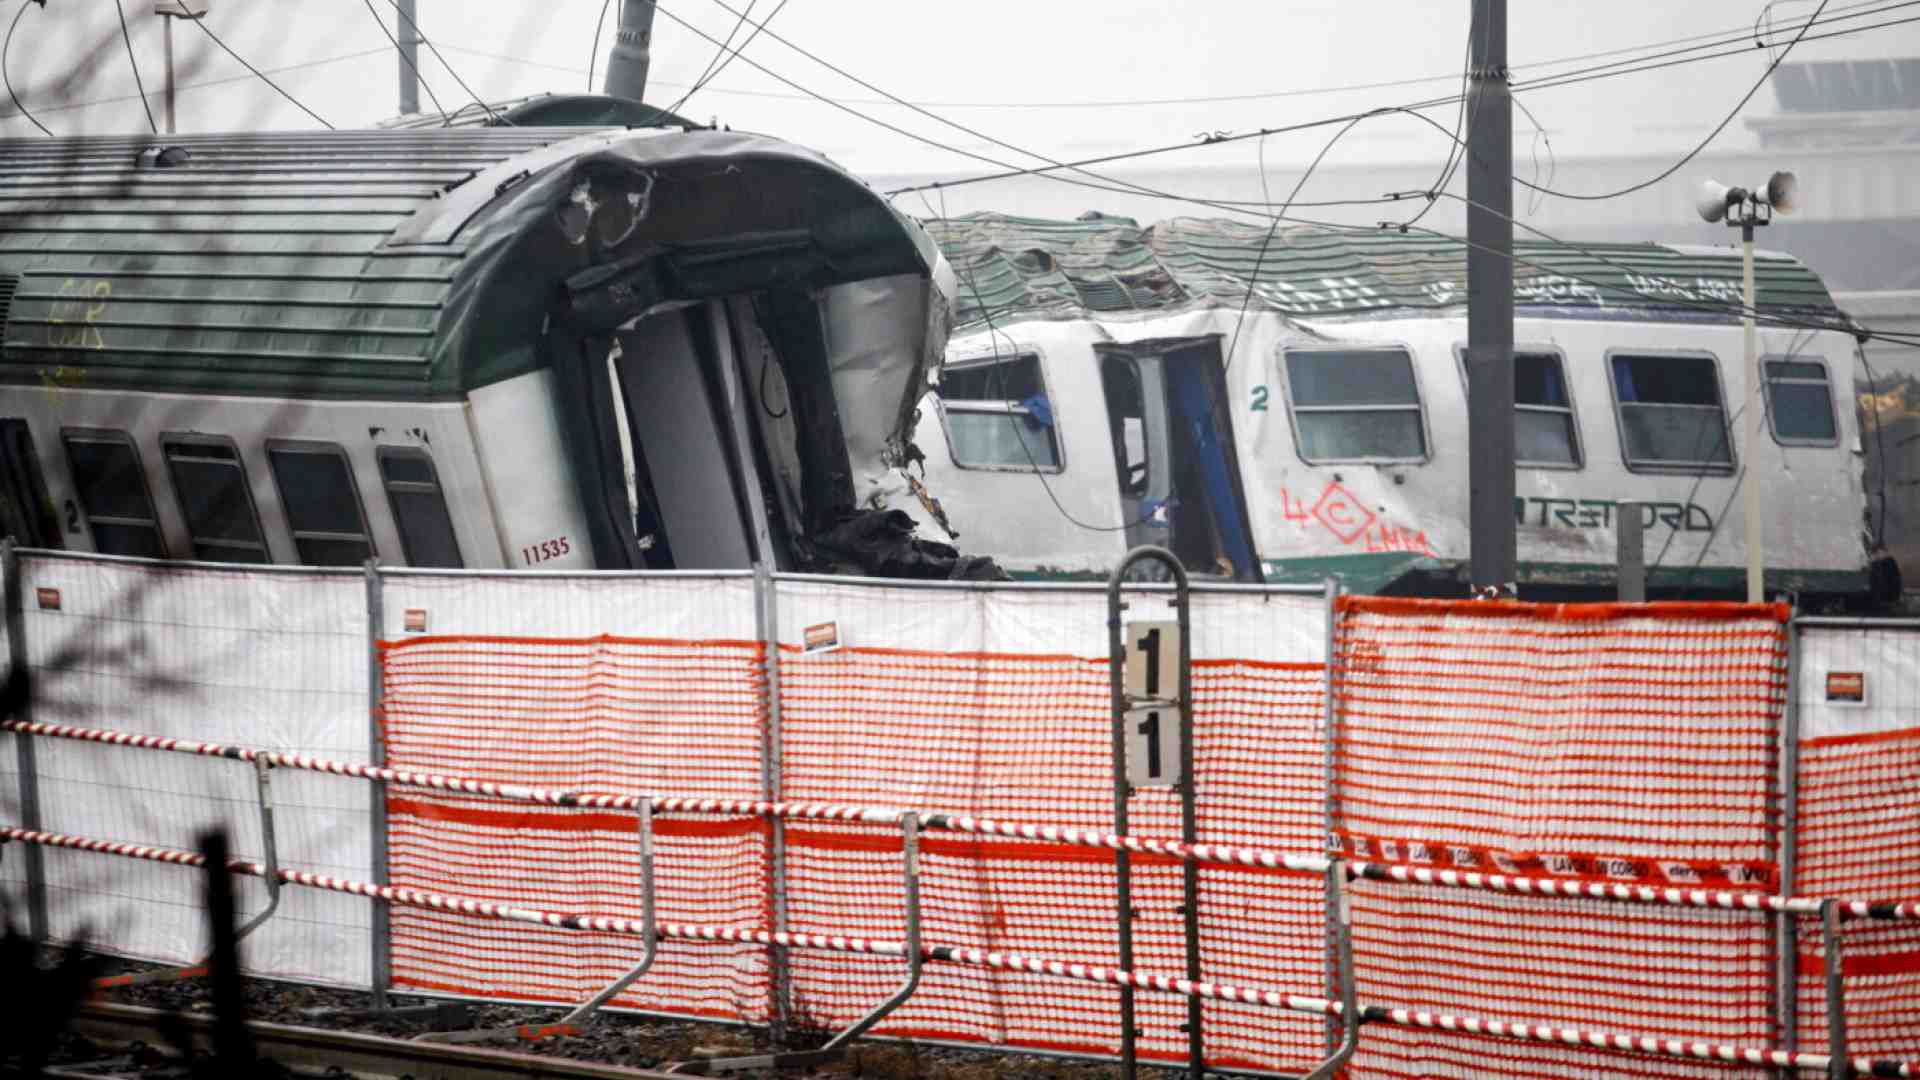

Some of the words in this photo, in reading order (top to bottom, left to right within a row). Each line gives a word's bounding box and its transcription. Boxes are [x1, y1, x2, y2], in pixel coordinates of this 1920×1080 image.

[1250, 385, 1269, 412] 2
[64, 499, 81, 535] 2
[522, 536, 570, 566] 11535
[1137, 628, 1160, 695] 1
[1137, 711, 1161, 778] 1
[1611, 860, 1649, 877] CORSO
